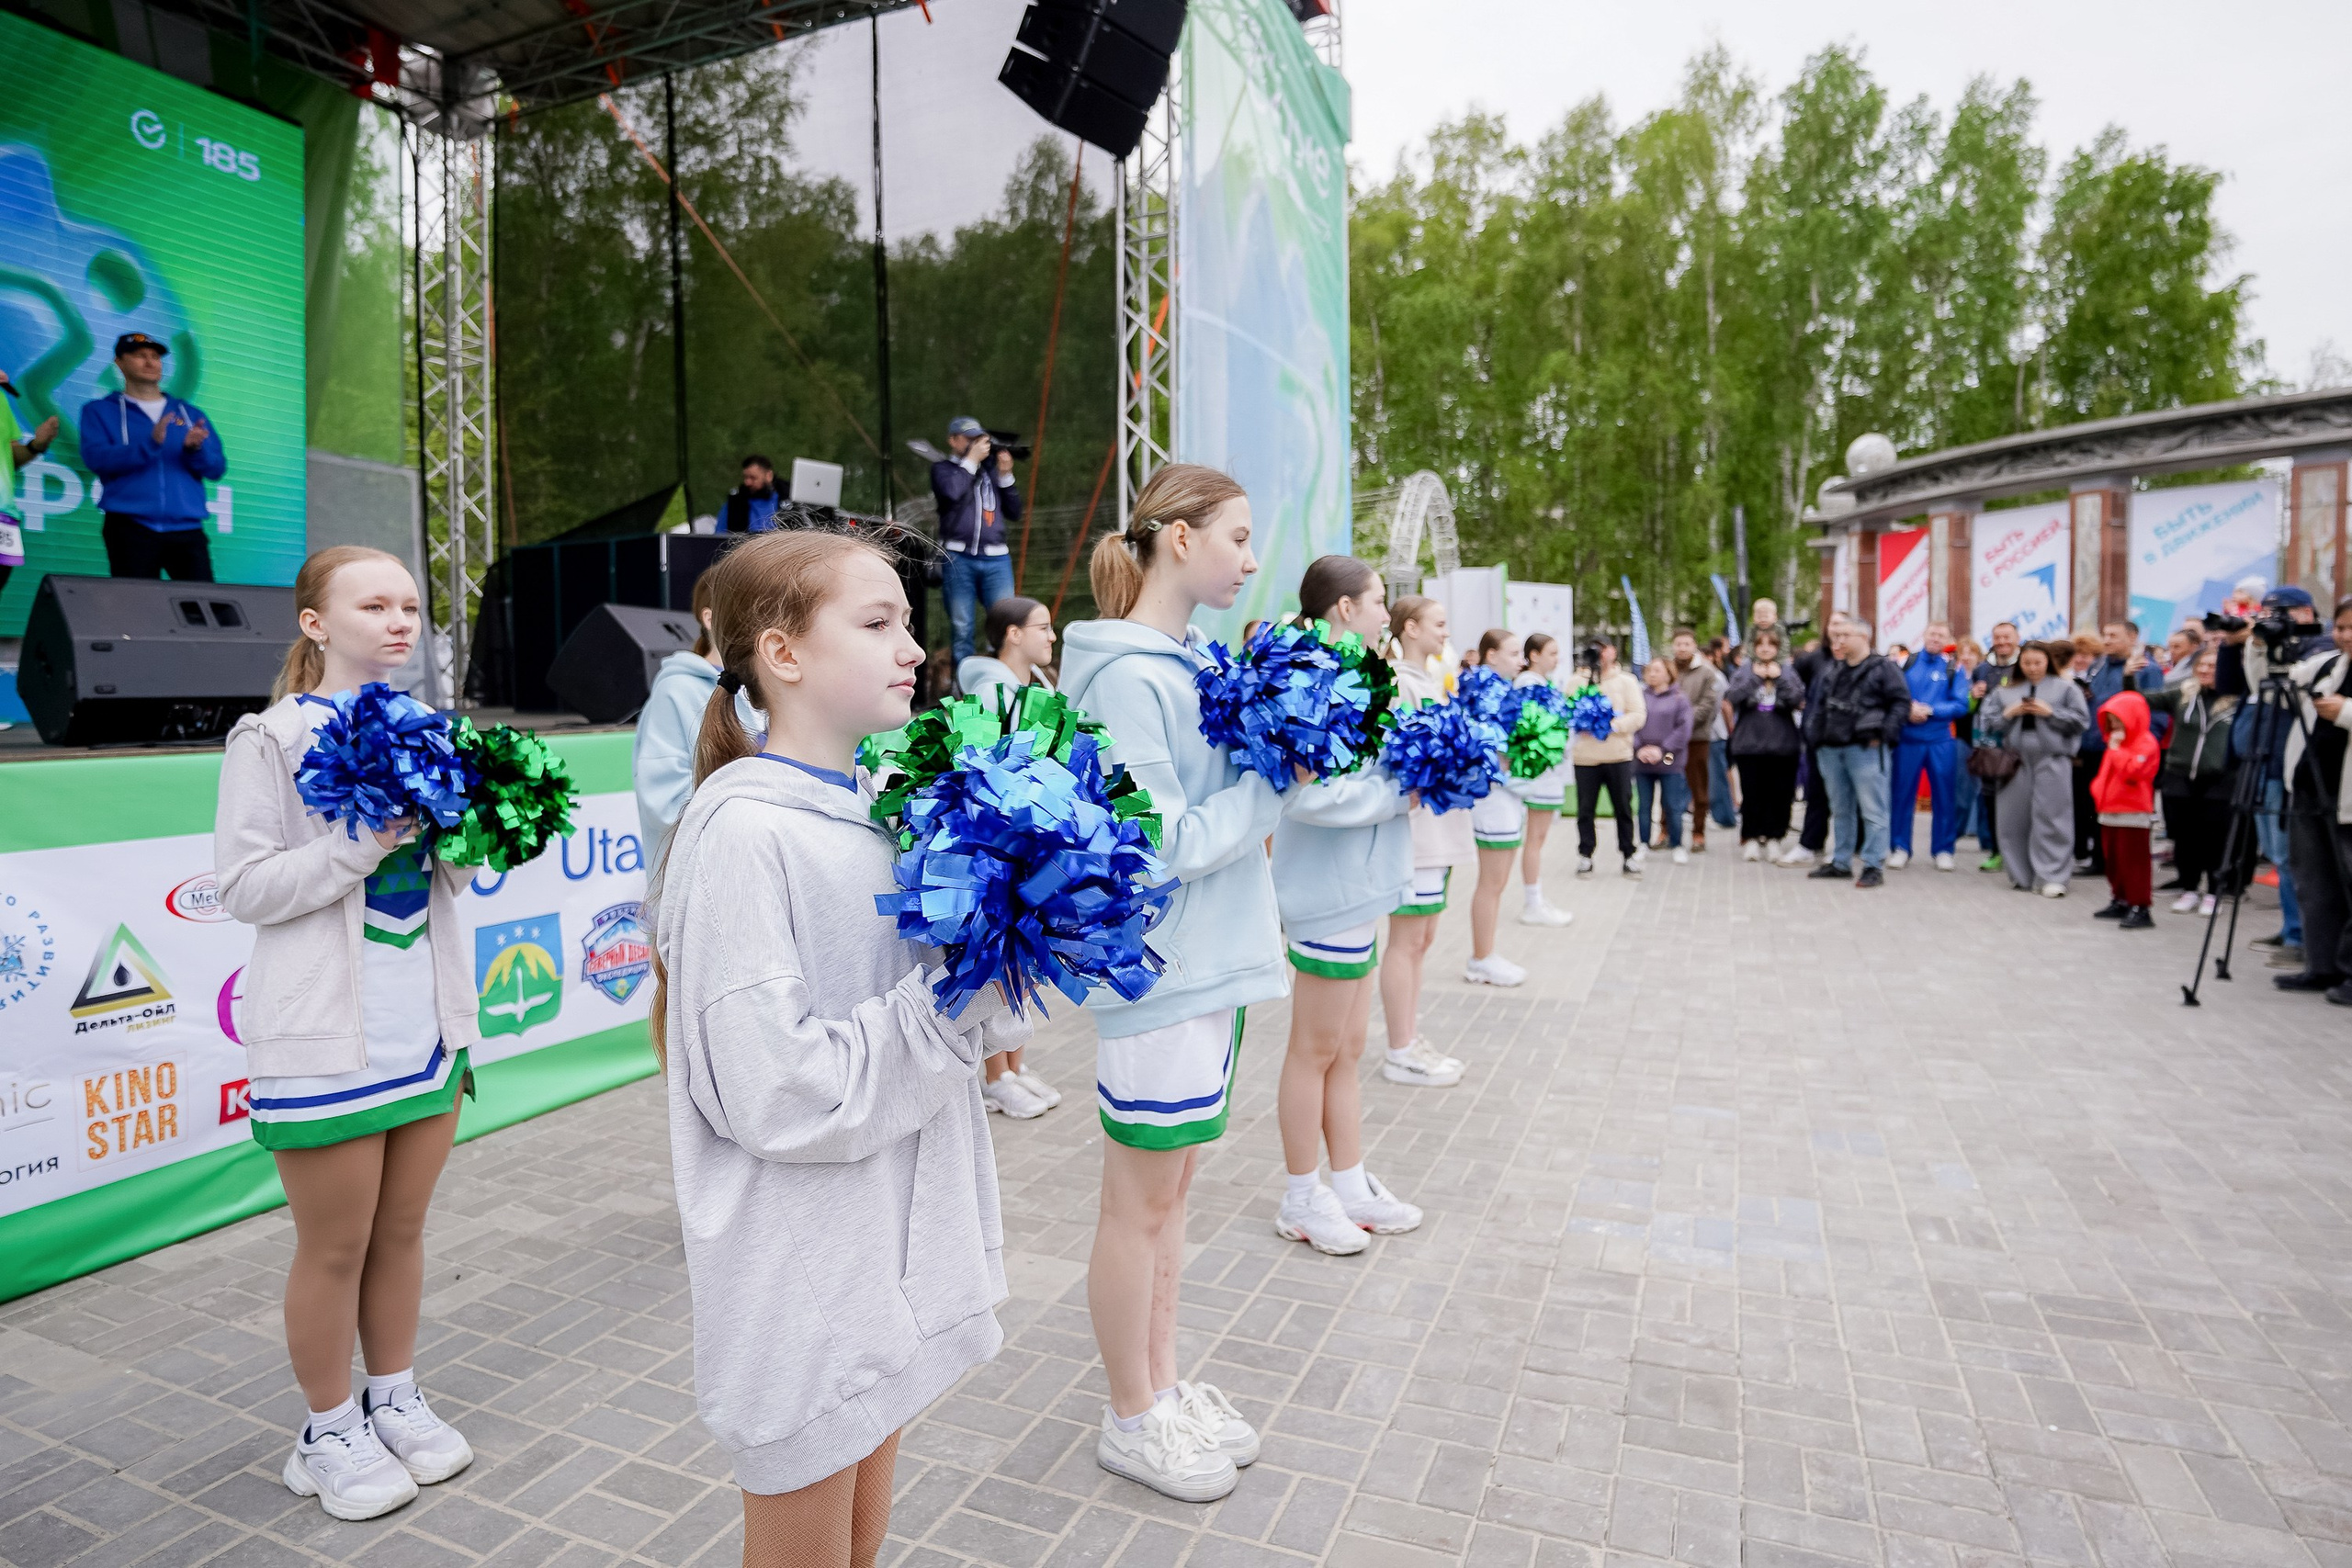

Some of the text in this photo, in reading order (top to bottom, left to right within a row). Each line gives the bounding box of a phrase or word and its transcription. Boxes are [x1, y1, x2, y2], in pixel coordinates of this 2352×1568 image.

[195, 137, 261, 182] 185
[84, 1061, 177, 1119] KINO
[86, 1103, 178, 1161] STAR
